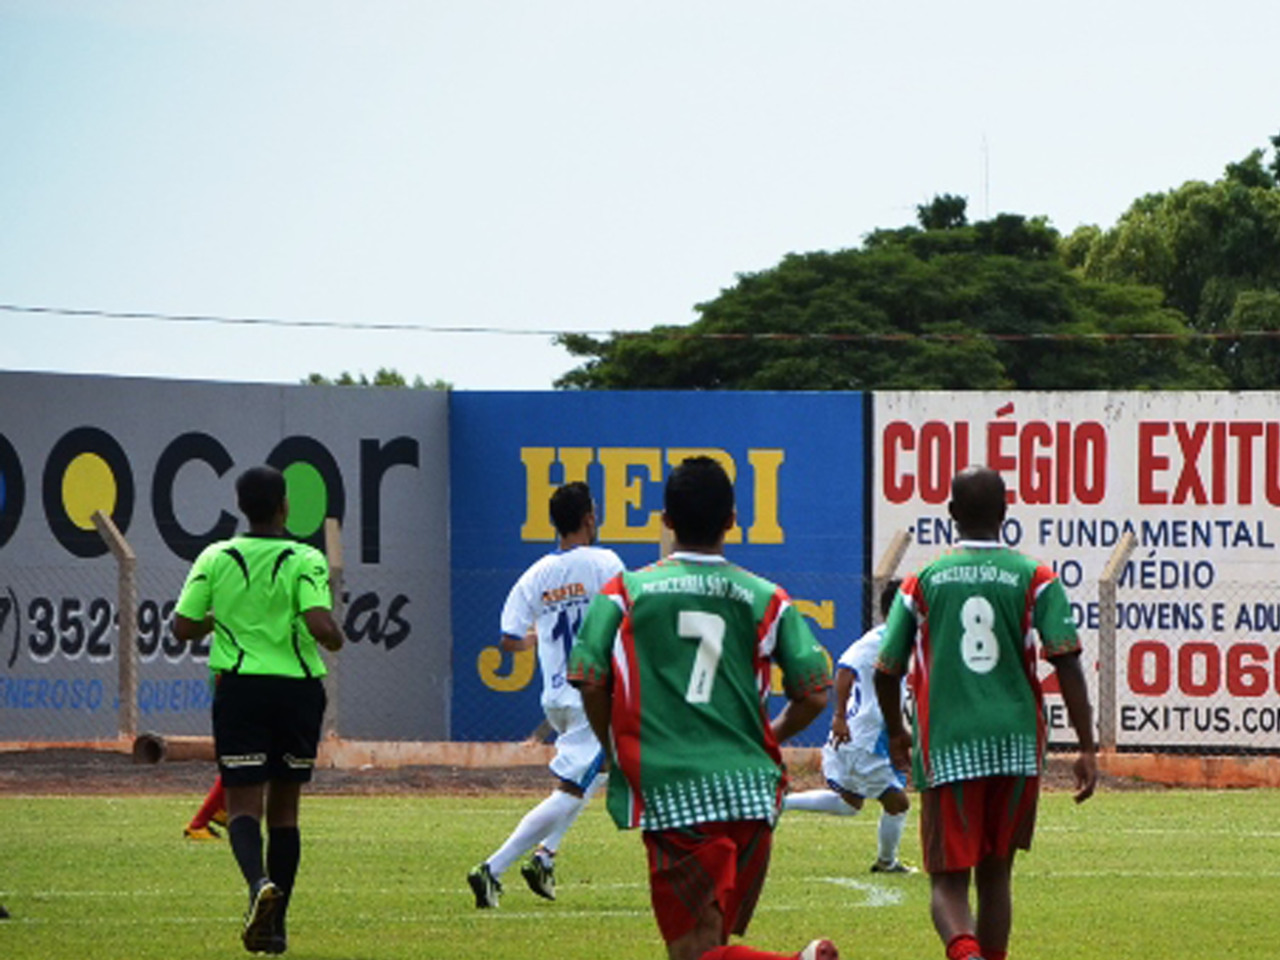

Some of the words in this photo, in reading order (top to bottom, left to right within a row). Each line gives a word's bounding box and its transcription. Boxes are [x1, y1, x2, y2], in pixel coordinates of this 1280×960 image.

[916, 517, 1022, 547] ENO
[960, 596, 999, 675] 8
[1115, 603, 1204, 630] JOVENS
[1212, 603, 1225, 631] E
[677, 611, 727, 704] 7
